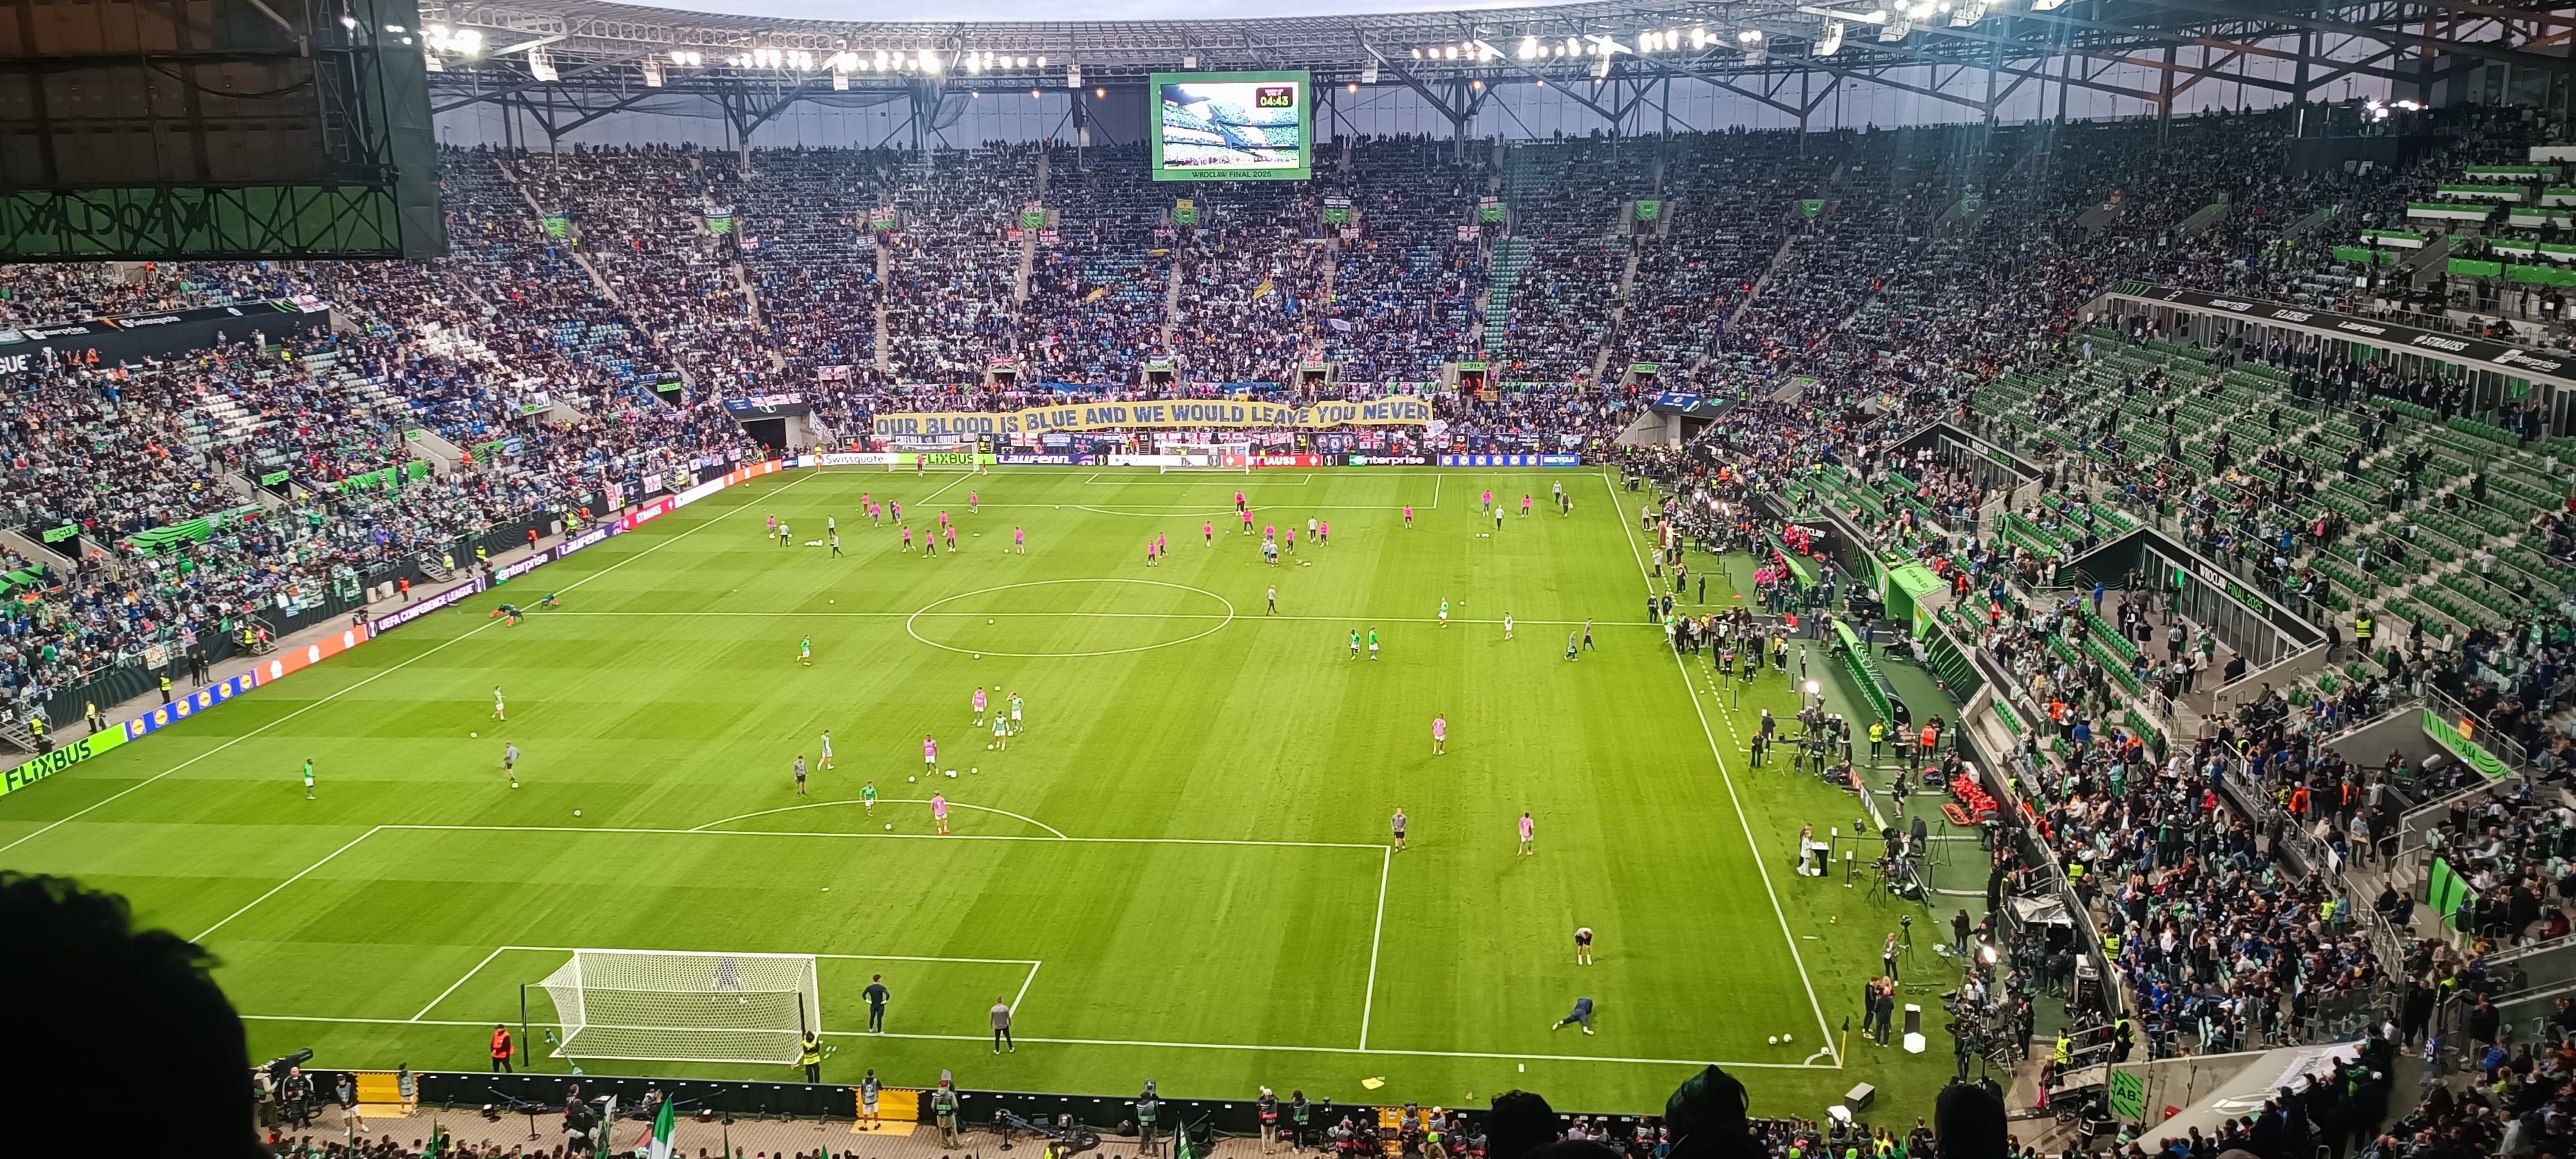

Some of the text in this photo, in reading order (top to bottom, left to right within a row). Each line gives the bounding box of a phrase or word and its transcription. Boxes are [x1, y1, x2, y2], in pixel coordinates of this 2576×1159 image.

[1260, 96, 1289, 107] 04:43
[2420, 335, 2471, 352] STRAUSS
[876, 402, 1430, 435] OUR BLOOD IS BLUE AND WE WOULD LEAVE YOU NEVER
[826, 454, 883, 463] Swissquote
[1352, 455, 1425, 466] enterprise
[636, 504, 662, 523] STRAUSS
[58, 527, 72, 537] C13
[496, 552, 549, 581] enterprise
[2199, 563, 2263, 614] WROCLAW FINAL 2025
[378, 583, 475, 630] UEFA CONFERENCE LEAGUE
[233, 619, 244, 631] 14
[0, 708, 13, 723] 13
[2461, 741, 2476, 761] A14
[2116, 1086, 2137, 1102] AB
